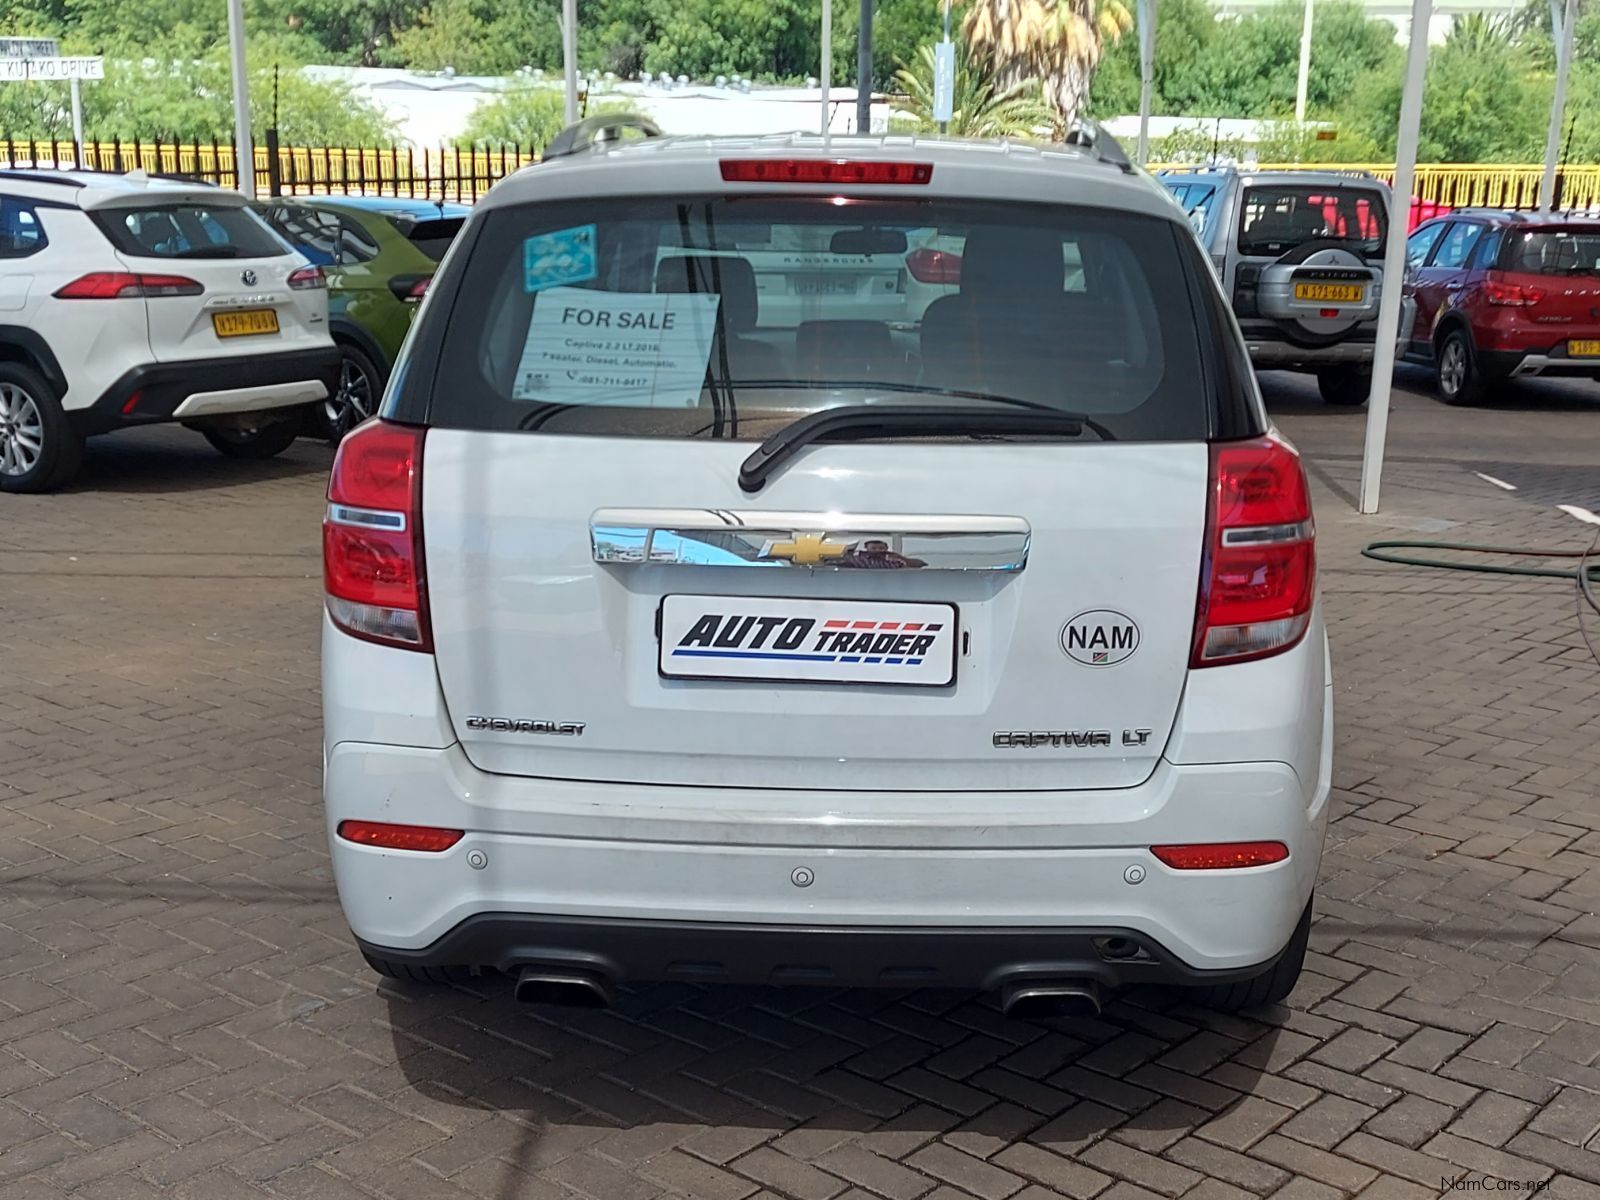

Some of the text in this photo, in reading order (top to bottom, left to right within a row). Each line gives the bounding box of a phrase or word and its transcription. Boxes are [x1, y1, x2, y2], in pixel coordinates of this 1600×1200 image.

[7, 60, 97, 77] KUTAKO DRIVE
[561, 307, 676, 330] FOR SALE
[564, 338, 603, 350] Captiva
[678, 614, 936, 656] AUTO TRADER
[1068, 625, 1133, 649] NAM
[466, 716, 586, 737] CHEVROLET
[993, 729, 1152, 748] CAPTIVA LT
